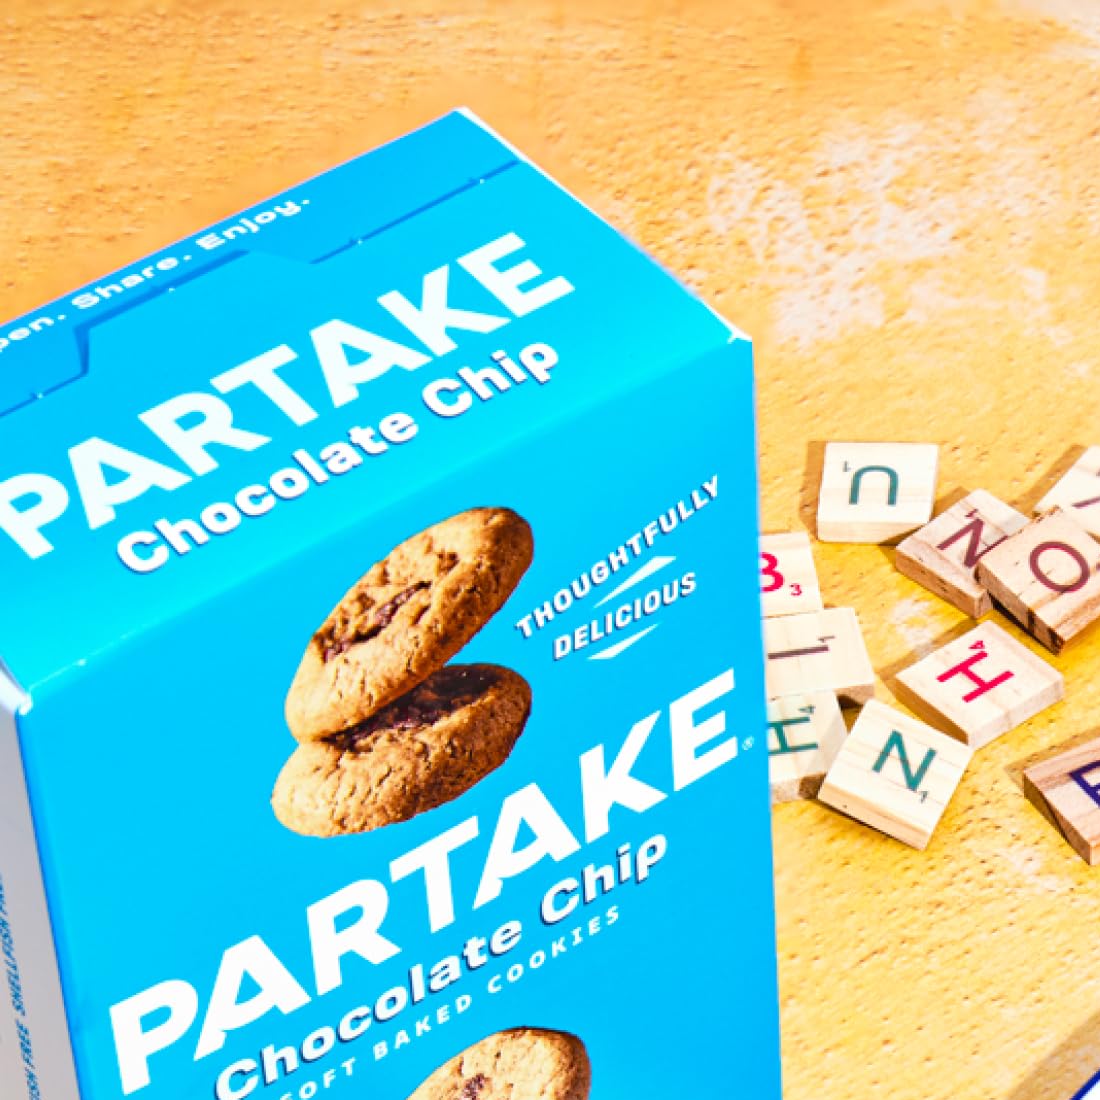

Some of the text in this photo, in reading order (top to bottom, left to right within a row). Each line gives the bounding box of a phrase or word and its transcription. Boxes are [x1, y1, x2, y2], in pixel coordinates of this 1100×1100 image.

[71, 255, 191, 308] Share.
[195, 199, 309, 249] Enjoy.
[0, 232, 574, 560] PARTAKE
[117, 343, 559, 573] Chocolate Chip
[515, 474, 718, 637] THOUGHTFULLY
[554, 571, 697, 660] DELICIOUS
[110, 669, 737, 1095] PARTAKE
[540, 834, 667, 925] Chip
[373, 994, 472, 1061] BAKED
[487, 906, 620, 993] COOKIES
